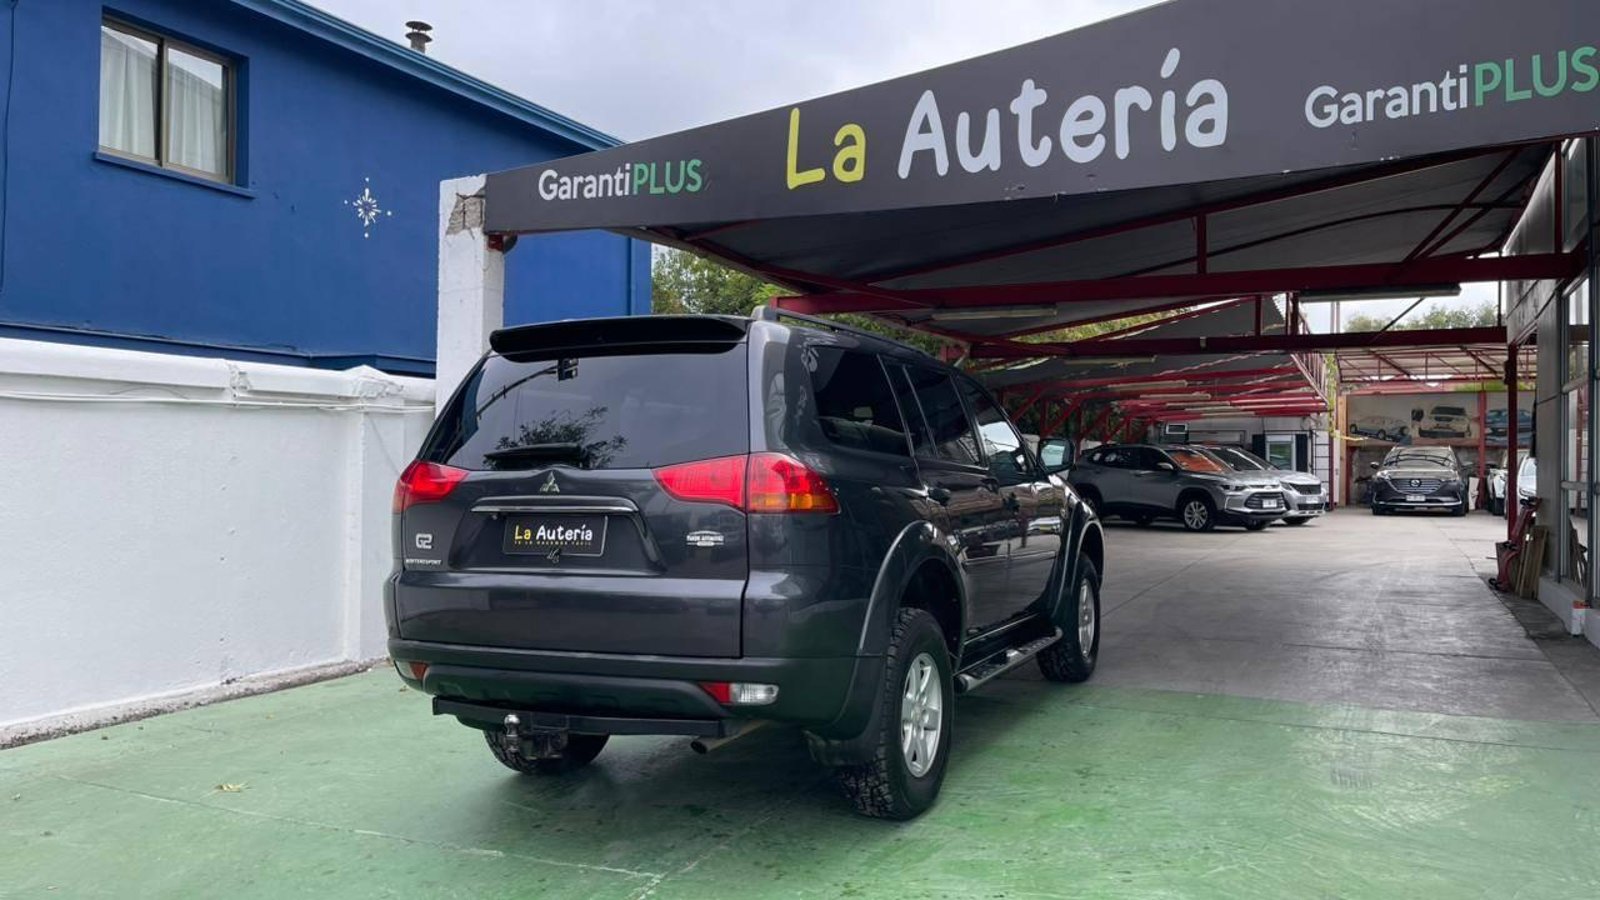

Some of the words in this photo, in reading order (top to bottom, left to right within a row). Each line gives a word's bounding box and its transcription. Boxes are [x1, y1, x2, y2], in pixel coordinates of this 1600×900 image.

[1304, 46, 1600, 128] GarantiPLUS
[787, 107, 866, 190] La
[898, 48, 1229, 179] Autería
[538, 159, 702, 201] GarantiPLUS
[514, 525, 531, 540] La
[536, 524, 593, 541] Autería
